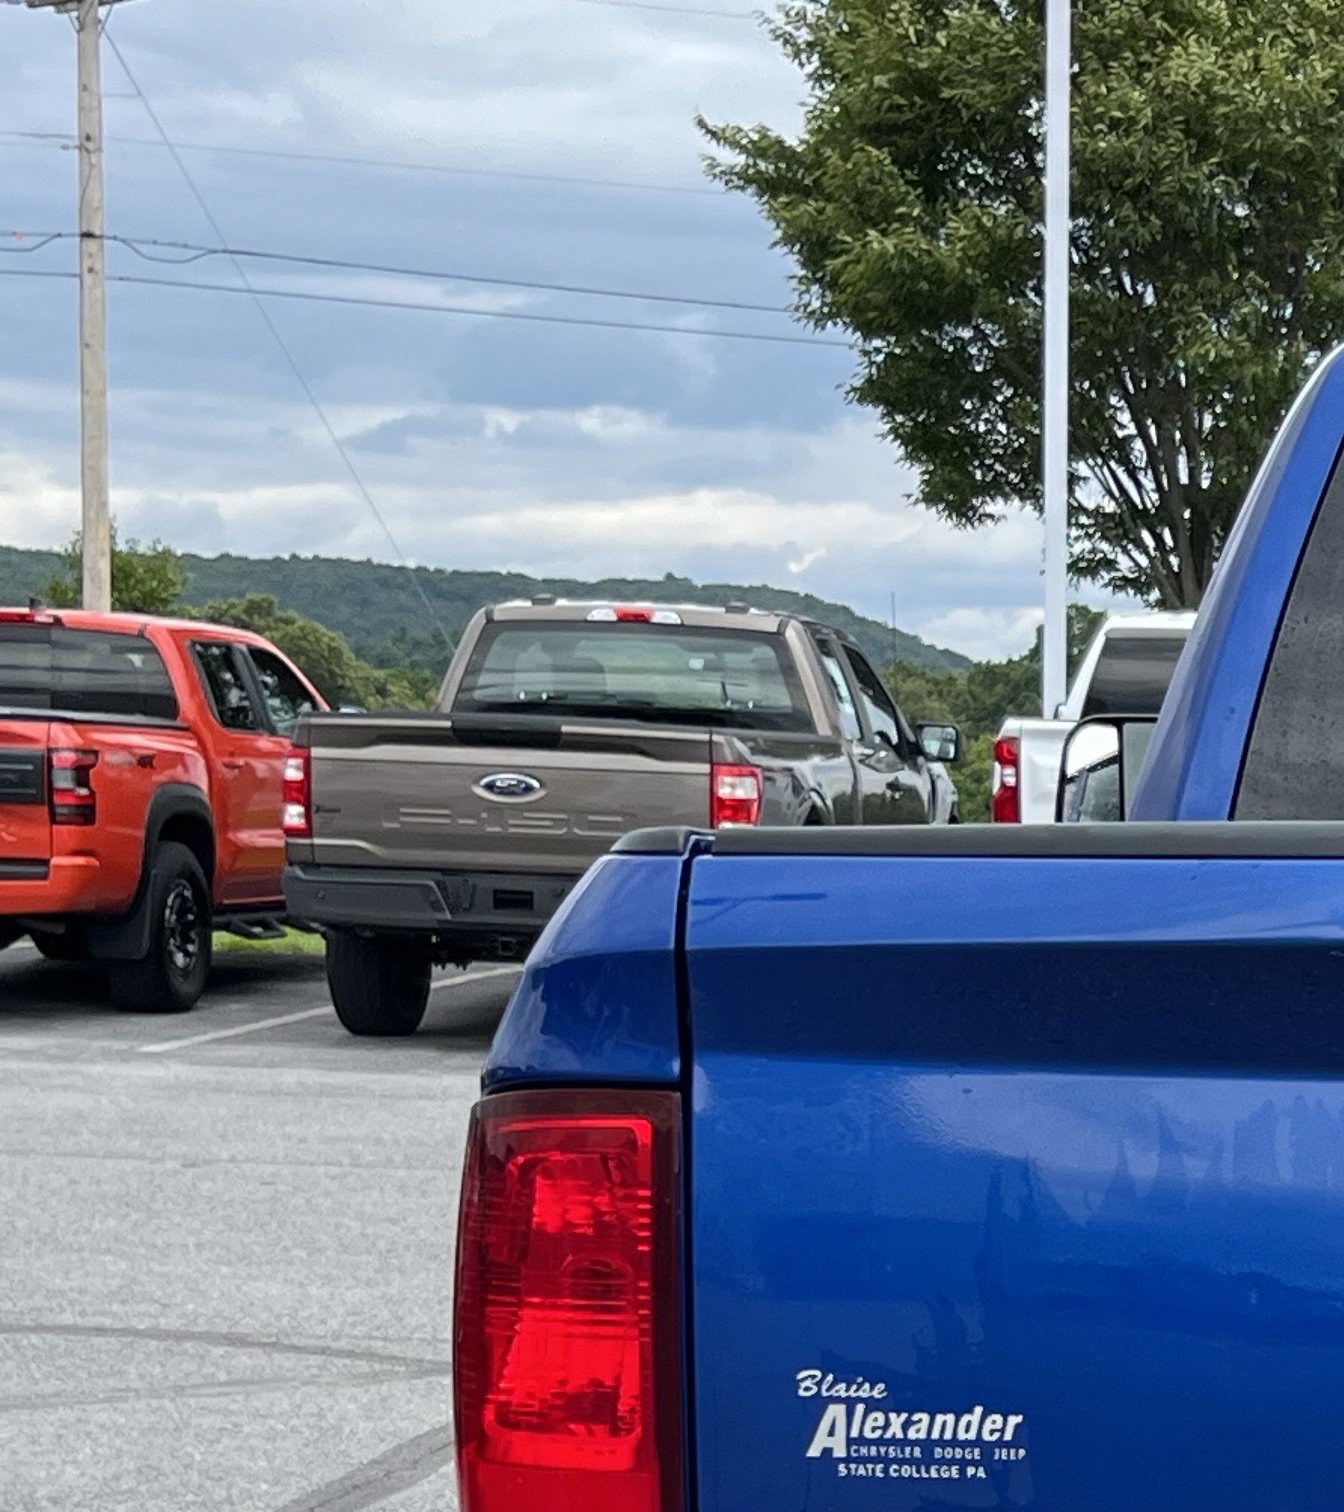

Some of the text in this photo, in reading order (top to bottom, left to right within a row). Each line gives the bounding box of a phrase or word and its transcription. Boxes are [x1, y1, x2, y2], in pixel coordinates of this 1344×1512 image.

[796, 1369, 888, 1398] Blaise
[806, 1403, 1023, 1458] Alexander
[850, 1445, 1026, 1460] CHRYSLER DODGE JEEP
[838, 1463, 987, 1479] STATE COLLEGE PA
